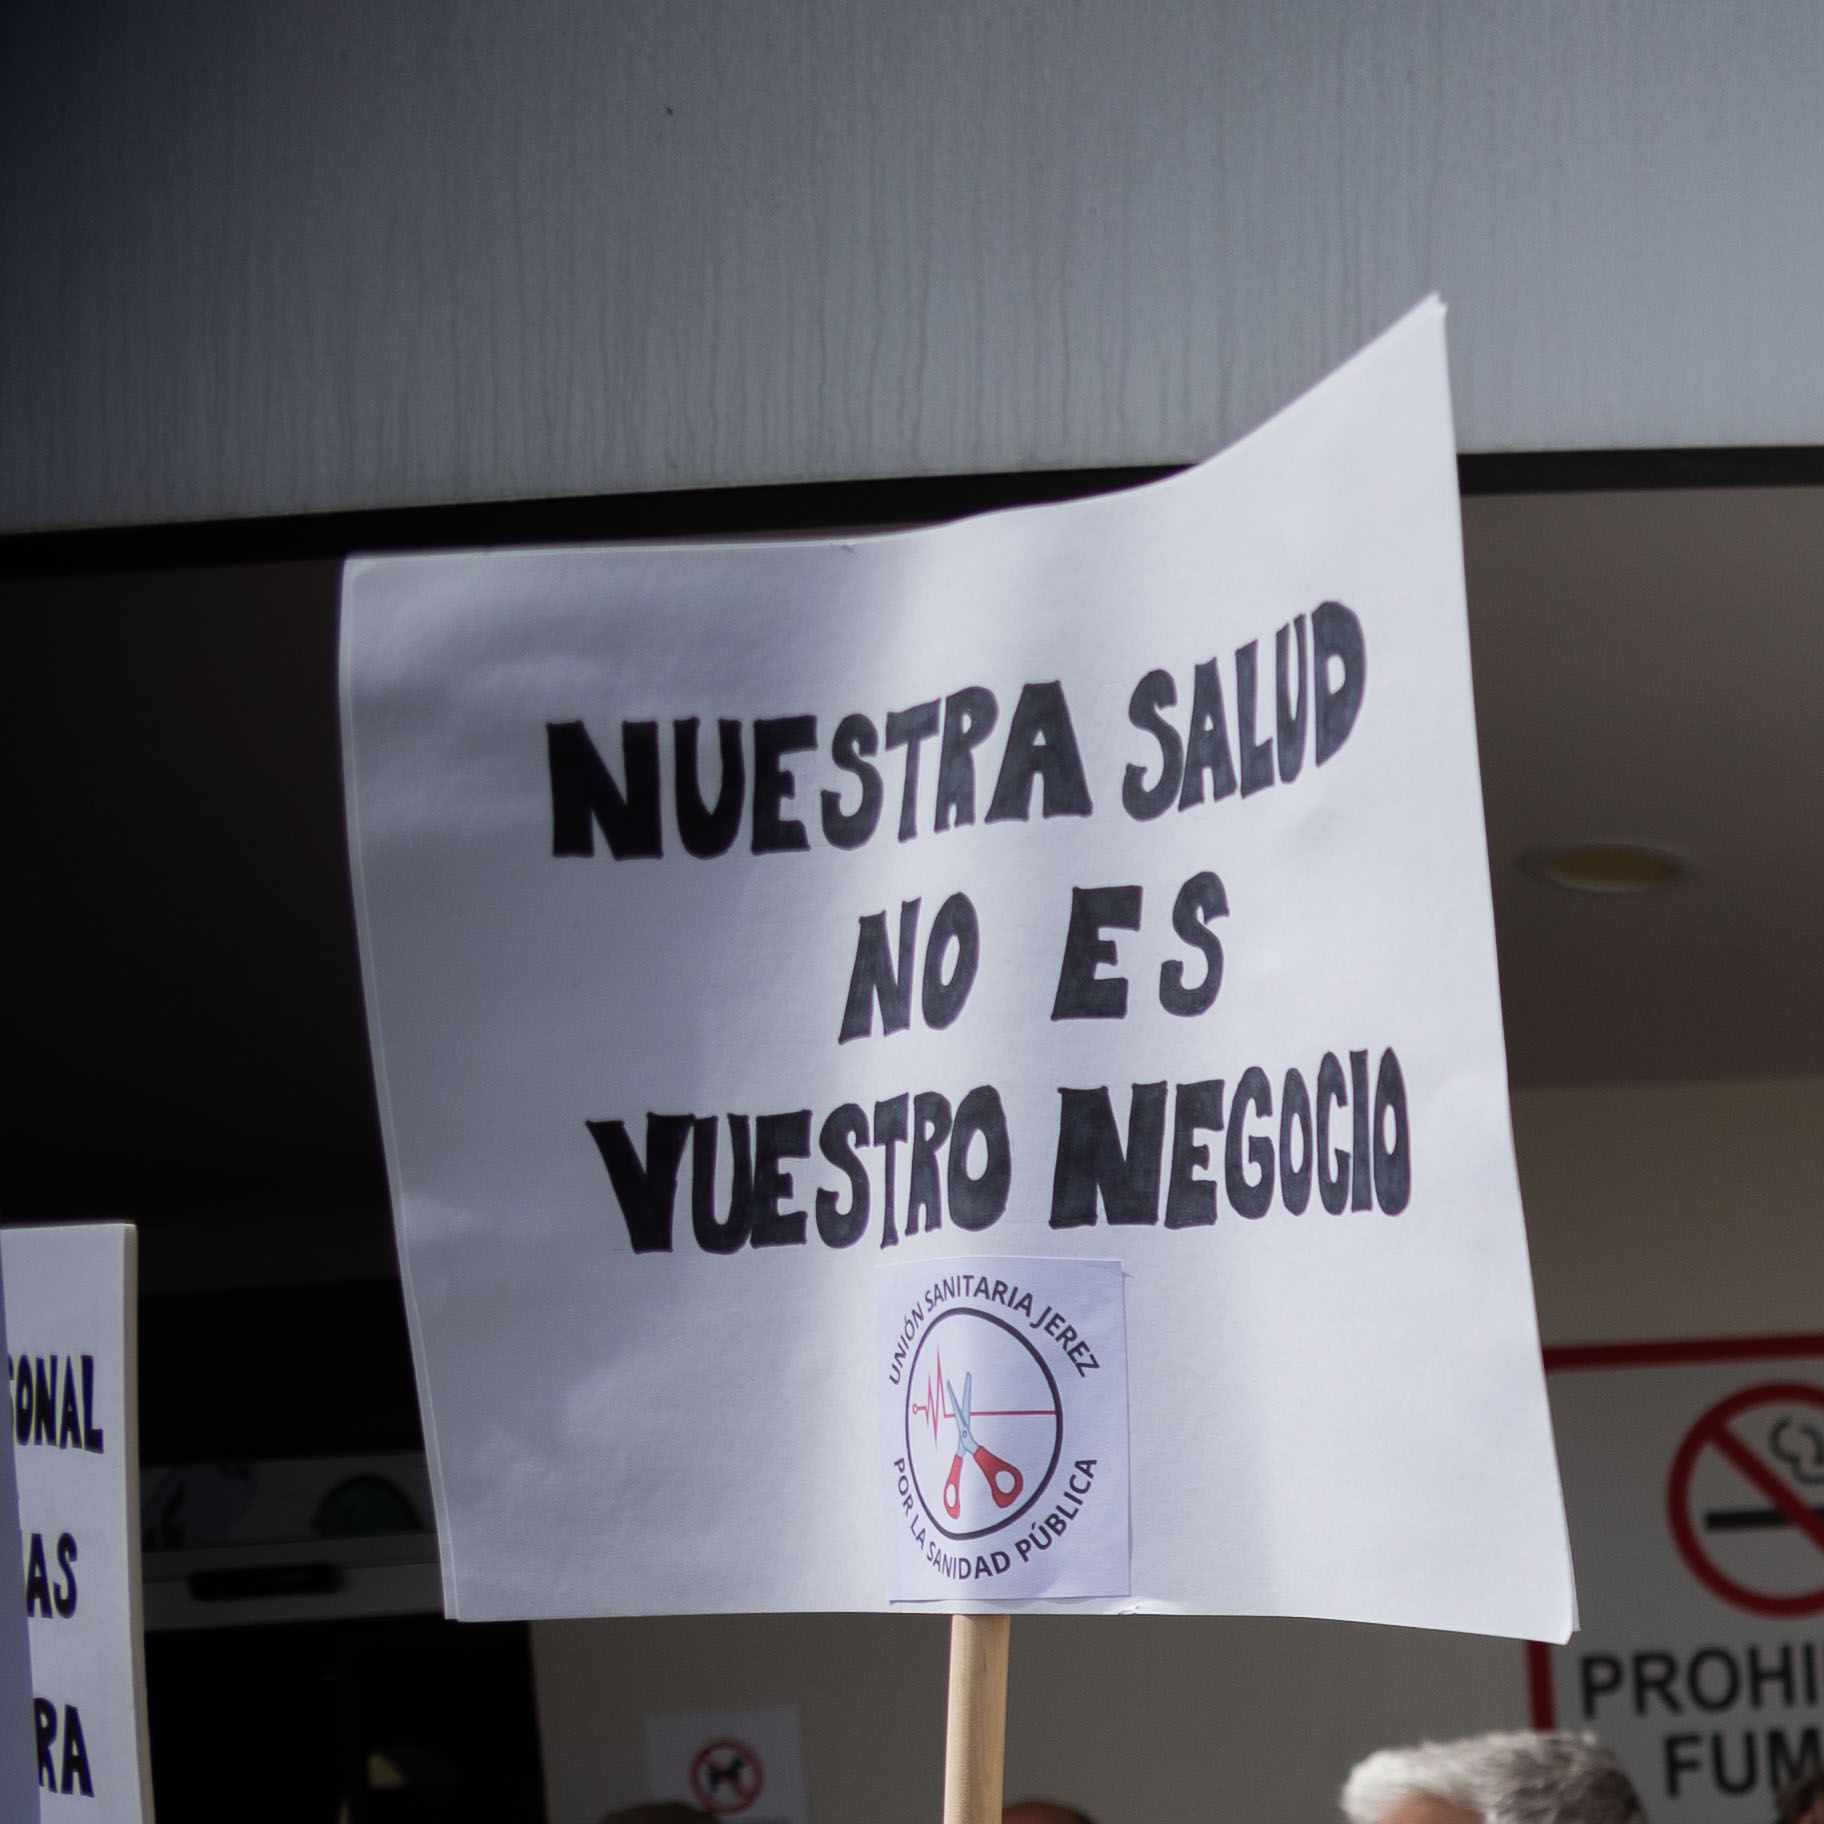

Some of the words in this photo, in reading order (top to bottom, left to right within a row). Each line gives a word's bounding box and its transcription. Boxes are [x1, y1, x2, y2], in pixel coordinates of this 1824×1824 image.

[546, 681, 1093, 862] NUESTRA
[1121, 600, 1368, 822] SALUD
[838, 891, 981, 1045] NO
[1050, 870, 1230, 1019] ES
[584, 1083, 1013, 1256] VUESTRO
[1049, 1046, 1412, 1232] NEGOCIO
[8, 1354, 104, 1454] ONAL
[888, 1301, 925, 1386] UNIÓN
[924, 1275, 1034, 1318] SANITARIA
[1030, 1306, 1100, 1378] JEREZ
[893, 1457, 914, 1518] POR
[910, 1516, 926, 1550] LA
[926, 1547, 1011, 1581] SANIDAD
[1014, 1457, 1098, 1563] PÚBLICA
